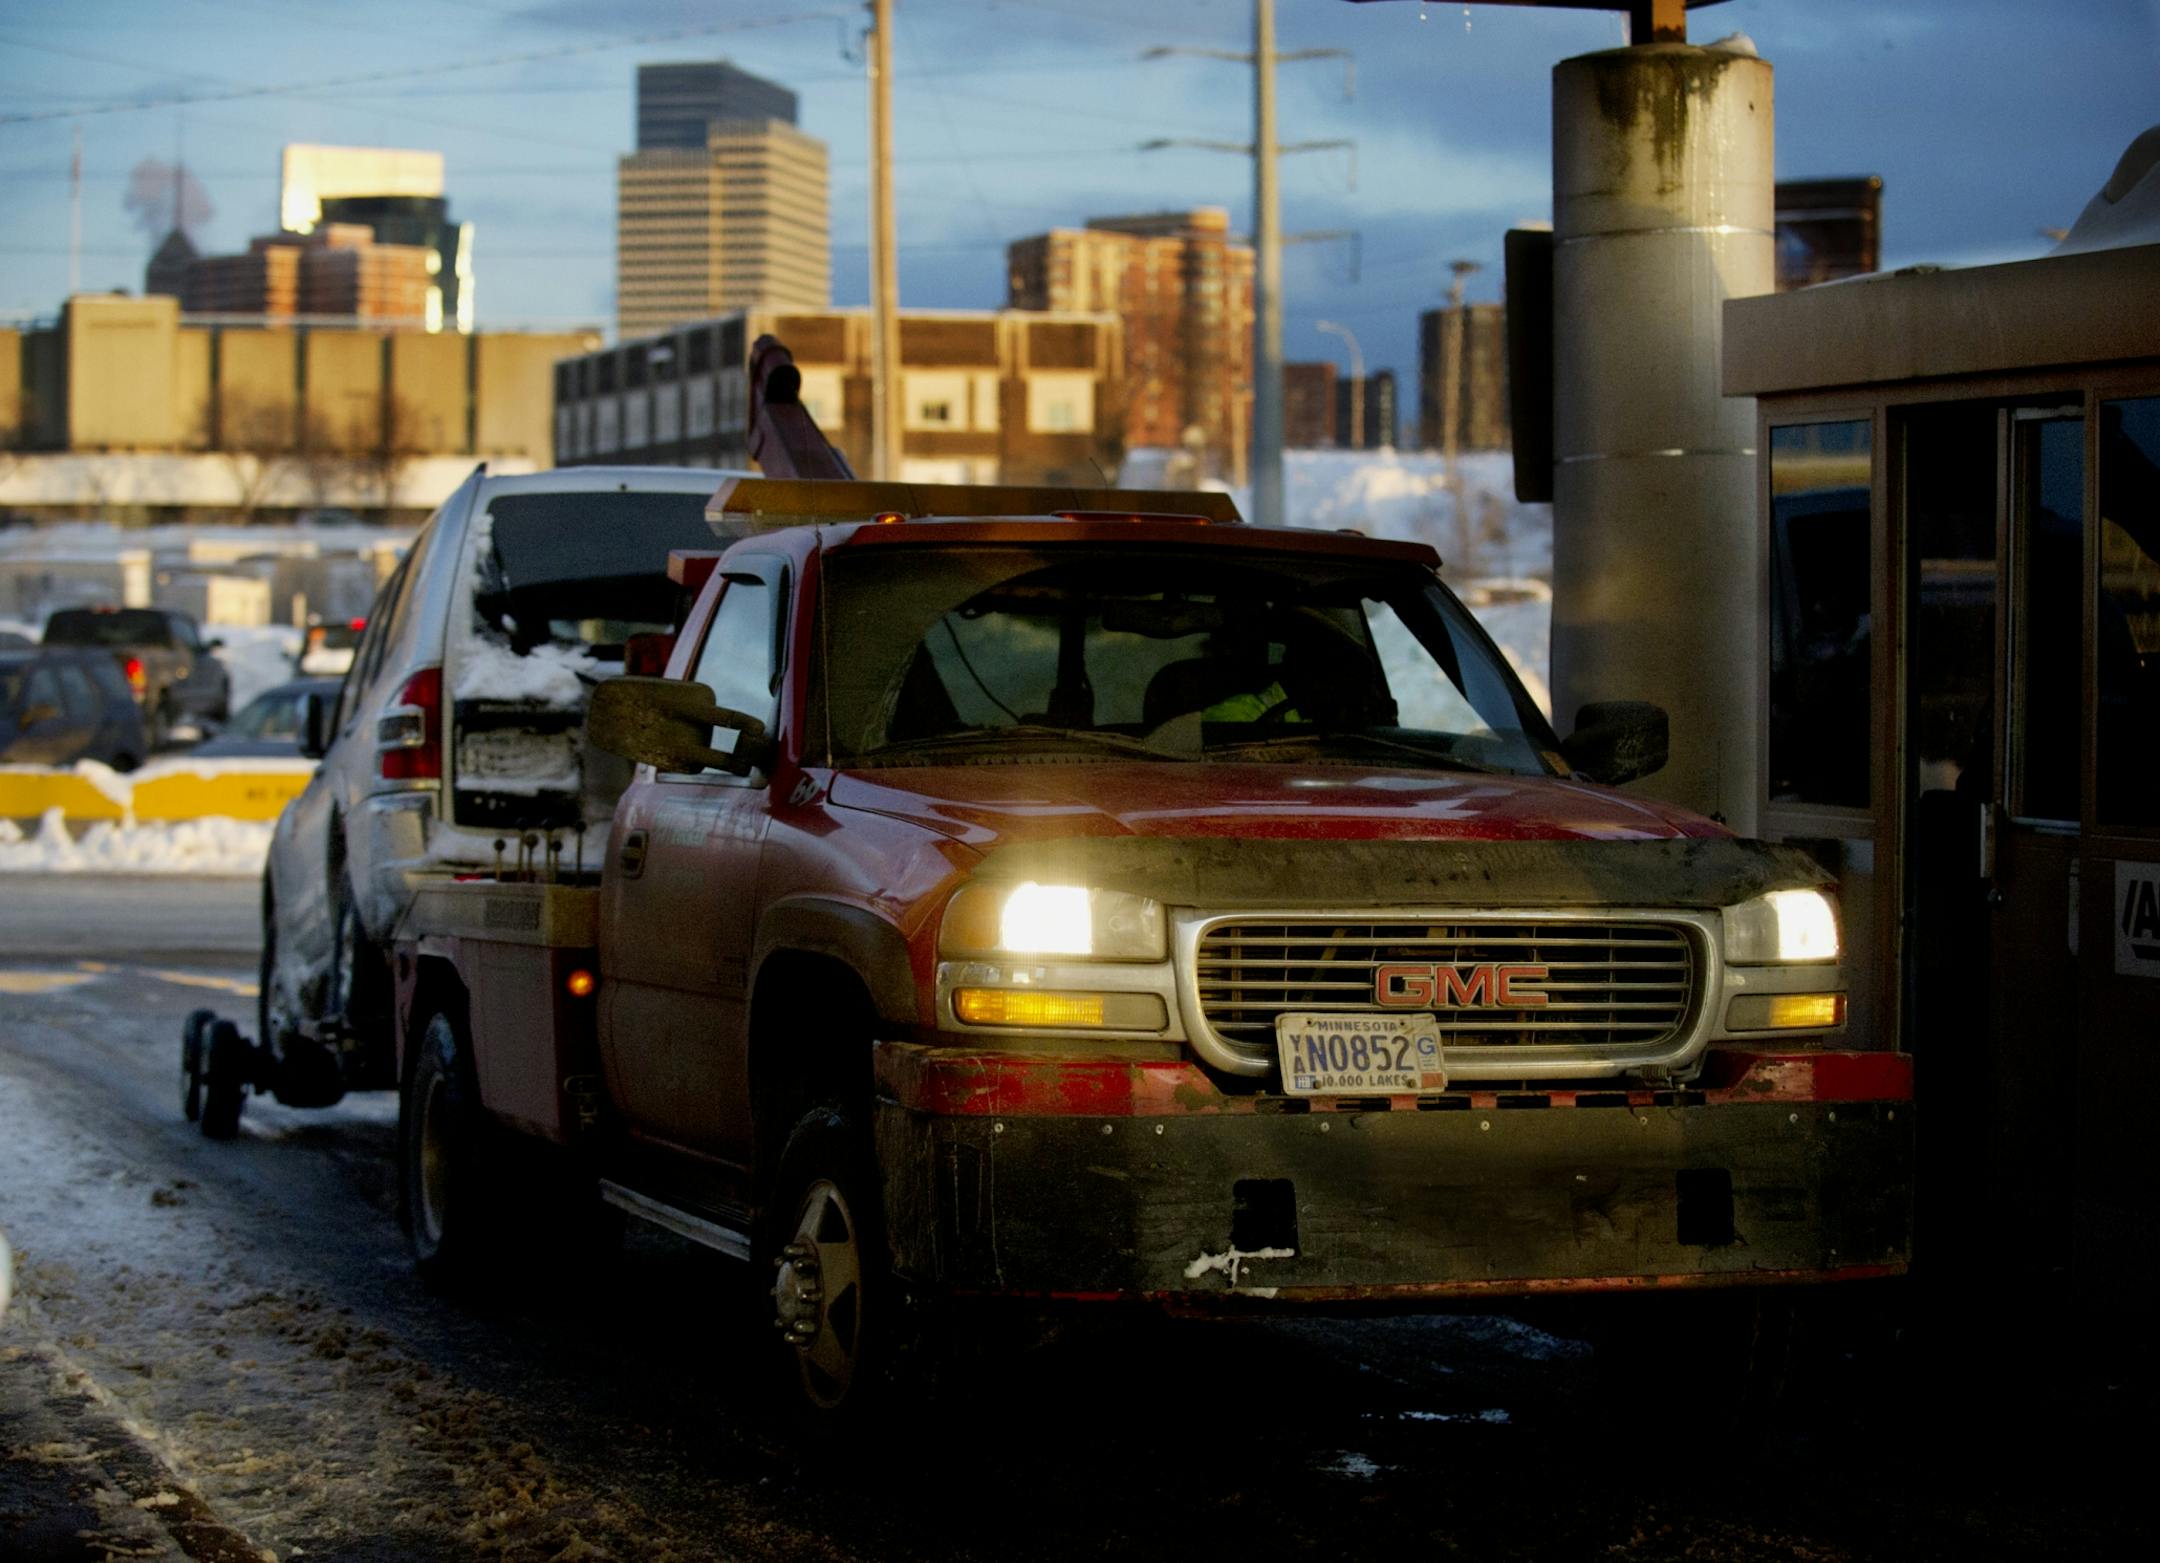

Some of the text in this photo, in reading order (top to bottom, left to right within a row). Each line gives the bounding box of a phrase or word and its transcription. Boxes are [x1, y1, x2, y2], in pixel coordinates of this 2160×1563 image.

[1375, 964, 1549, 1008] GMC
[1317, 1021, 1398, 1032] MINNESOTA
[1369, 1074, 1409, 1087] LAKES
